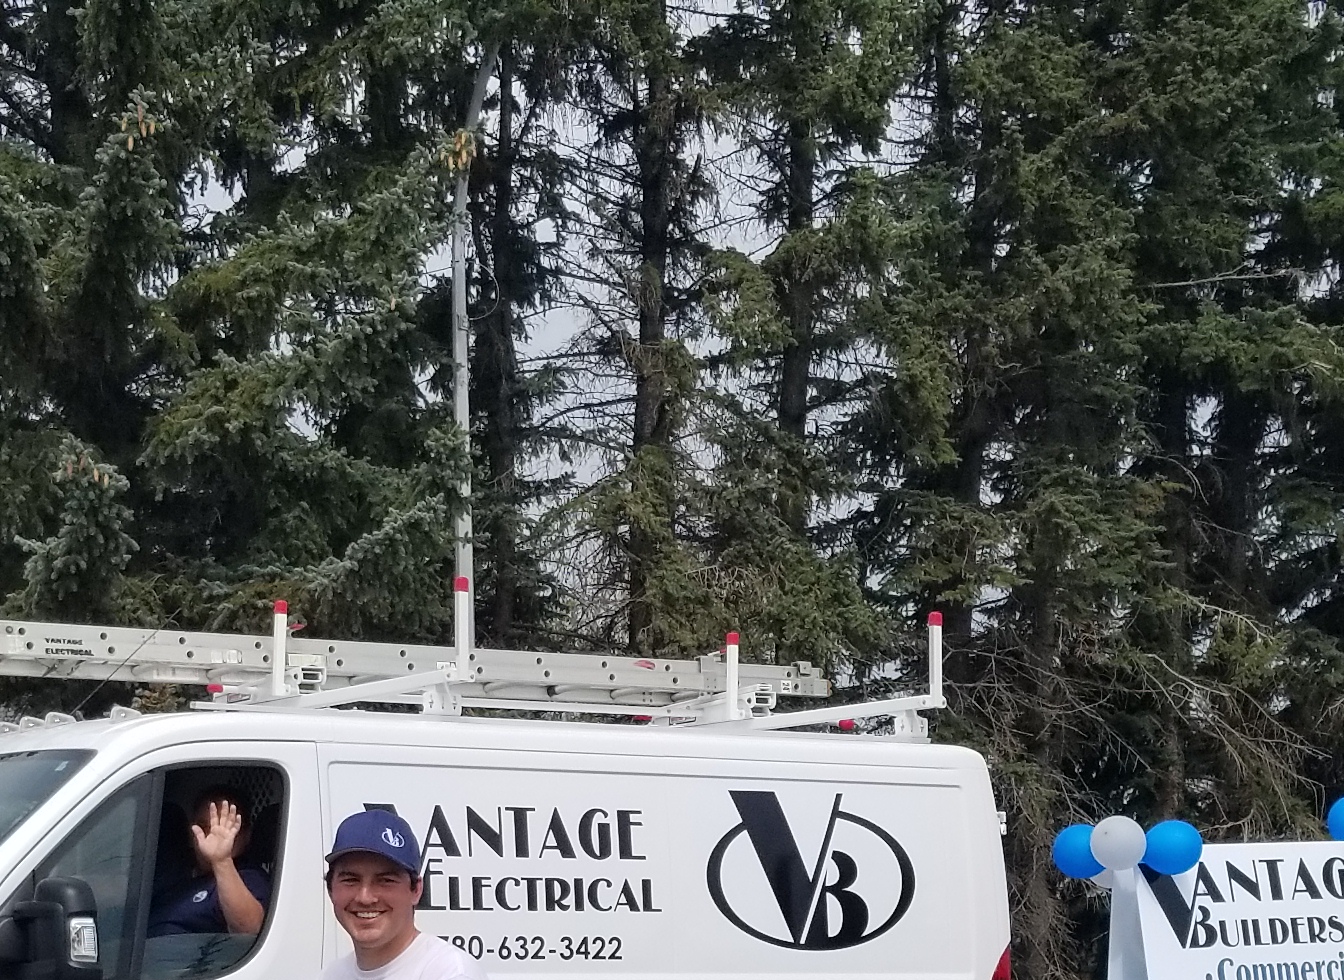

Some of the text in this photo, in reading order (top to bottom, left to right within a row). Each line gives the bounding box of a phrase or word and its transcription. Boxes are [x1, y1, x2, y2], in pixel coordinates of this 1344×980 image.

[44, 637, 84, 646] VANTAGE
[45, 647, 95, 657] ELECTRICAL
[415, 857, 663, 913] ELECTRICAL
